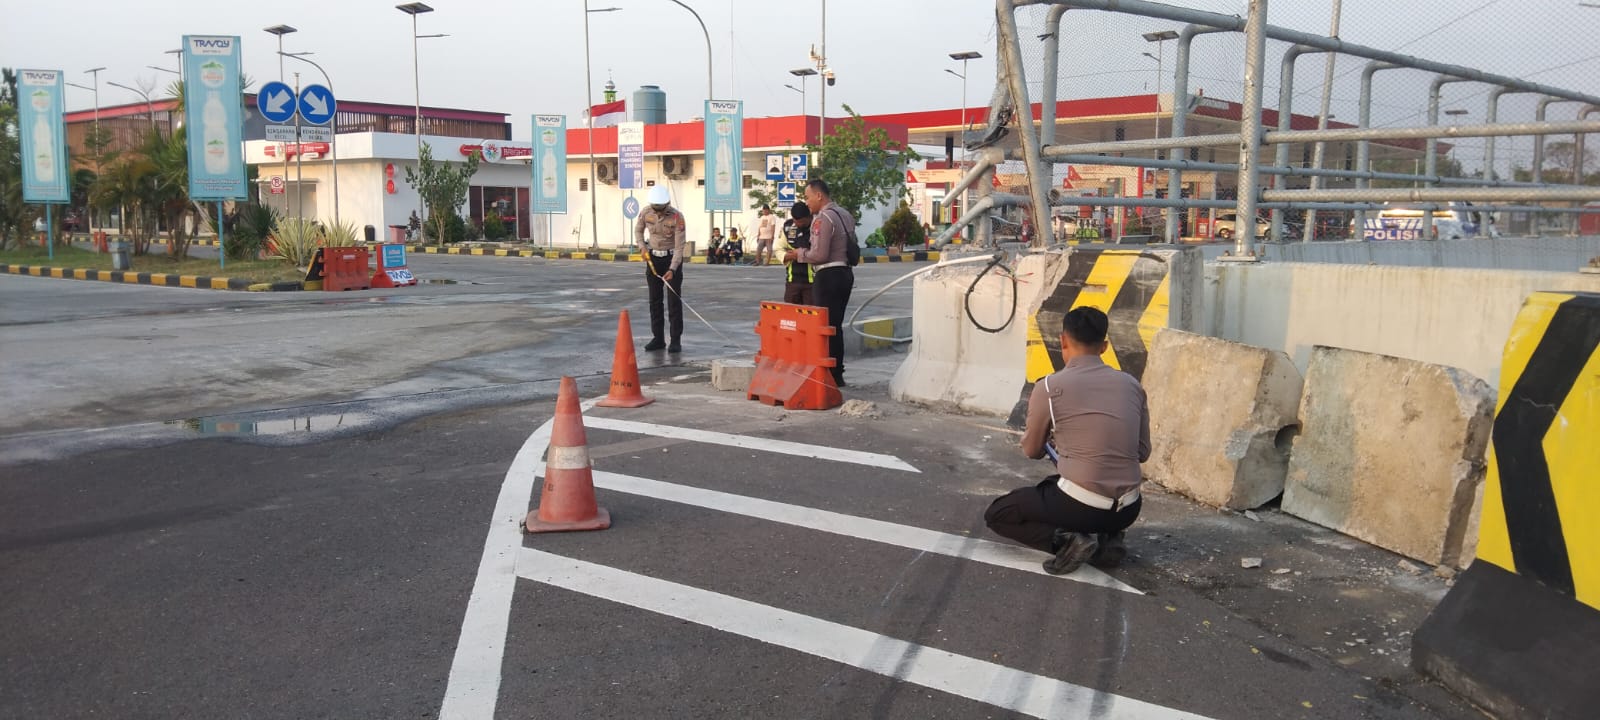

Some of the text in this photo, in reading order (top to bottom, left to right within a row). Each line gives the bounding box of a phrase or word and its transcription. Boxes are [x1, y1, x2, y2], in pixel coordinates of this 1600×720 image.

[194, 39, 230, 48] TRAVOY
[790, 156, 801, 170] P
[1363, 230, 1420, 240] POLISI
